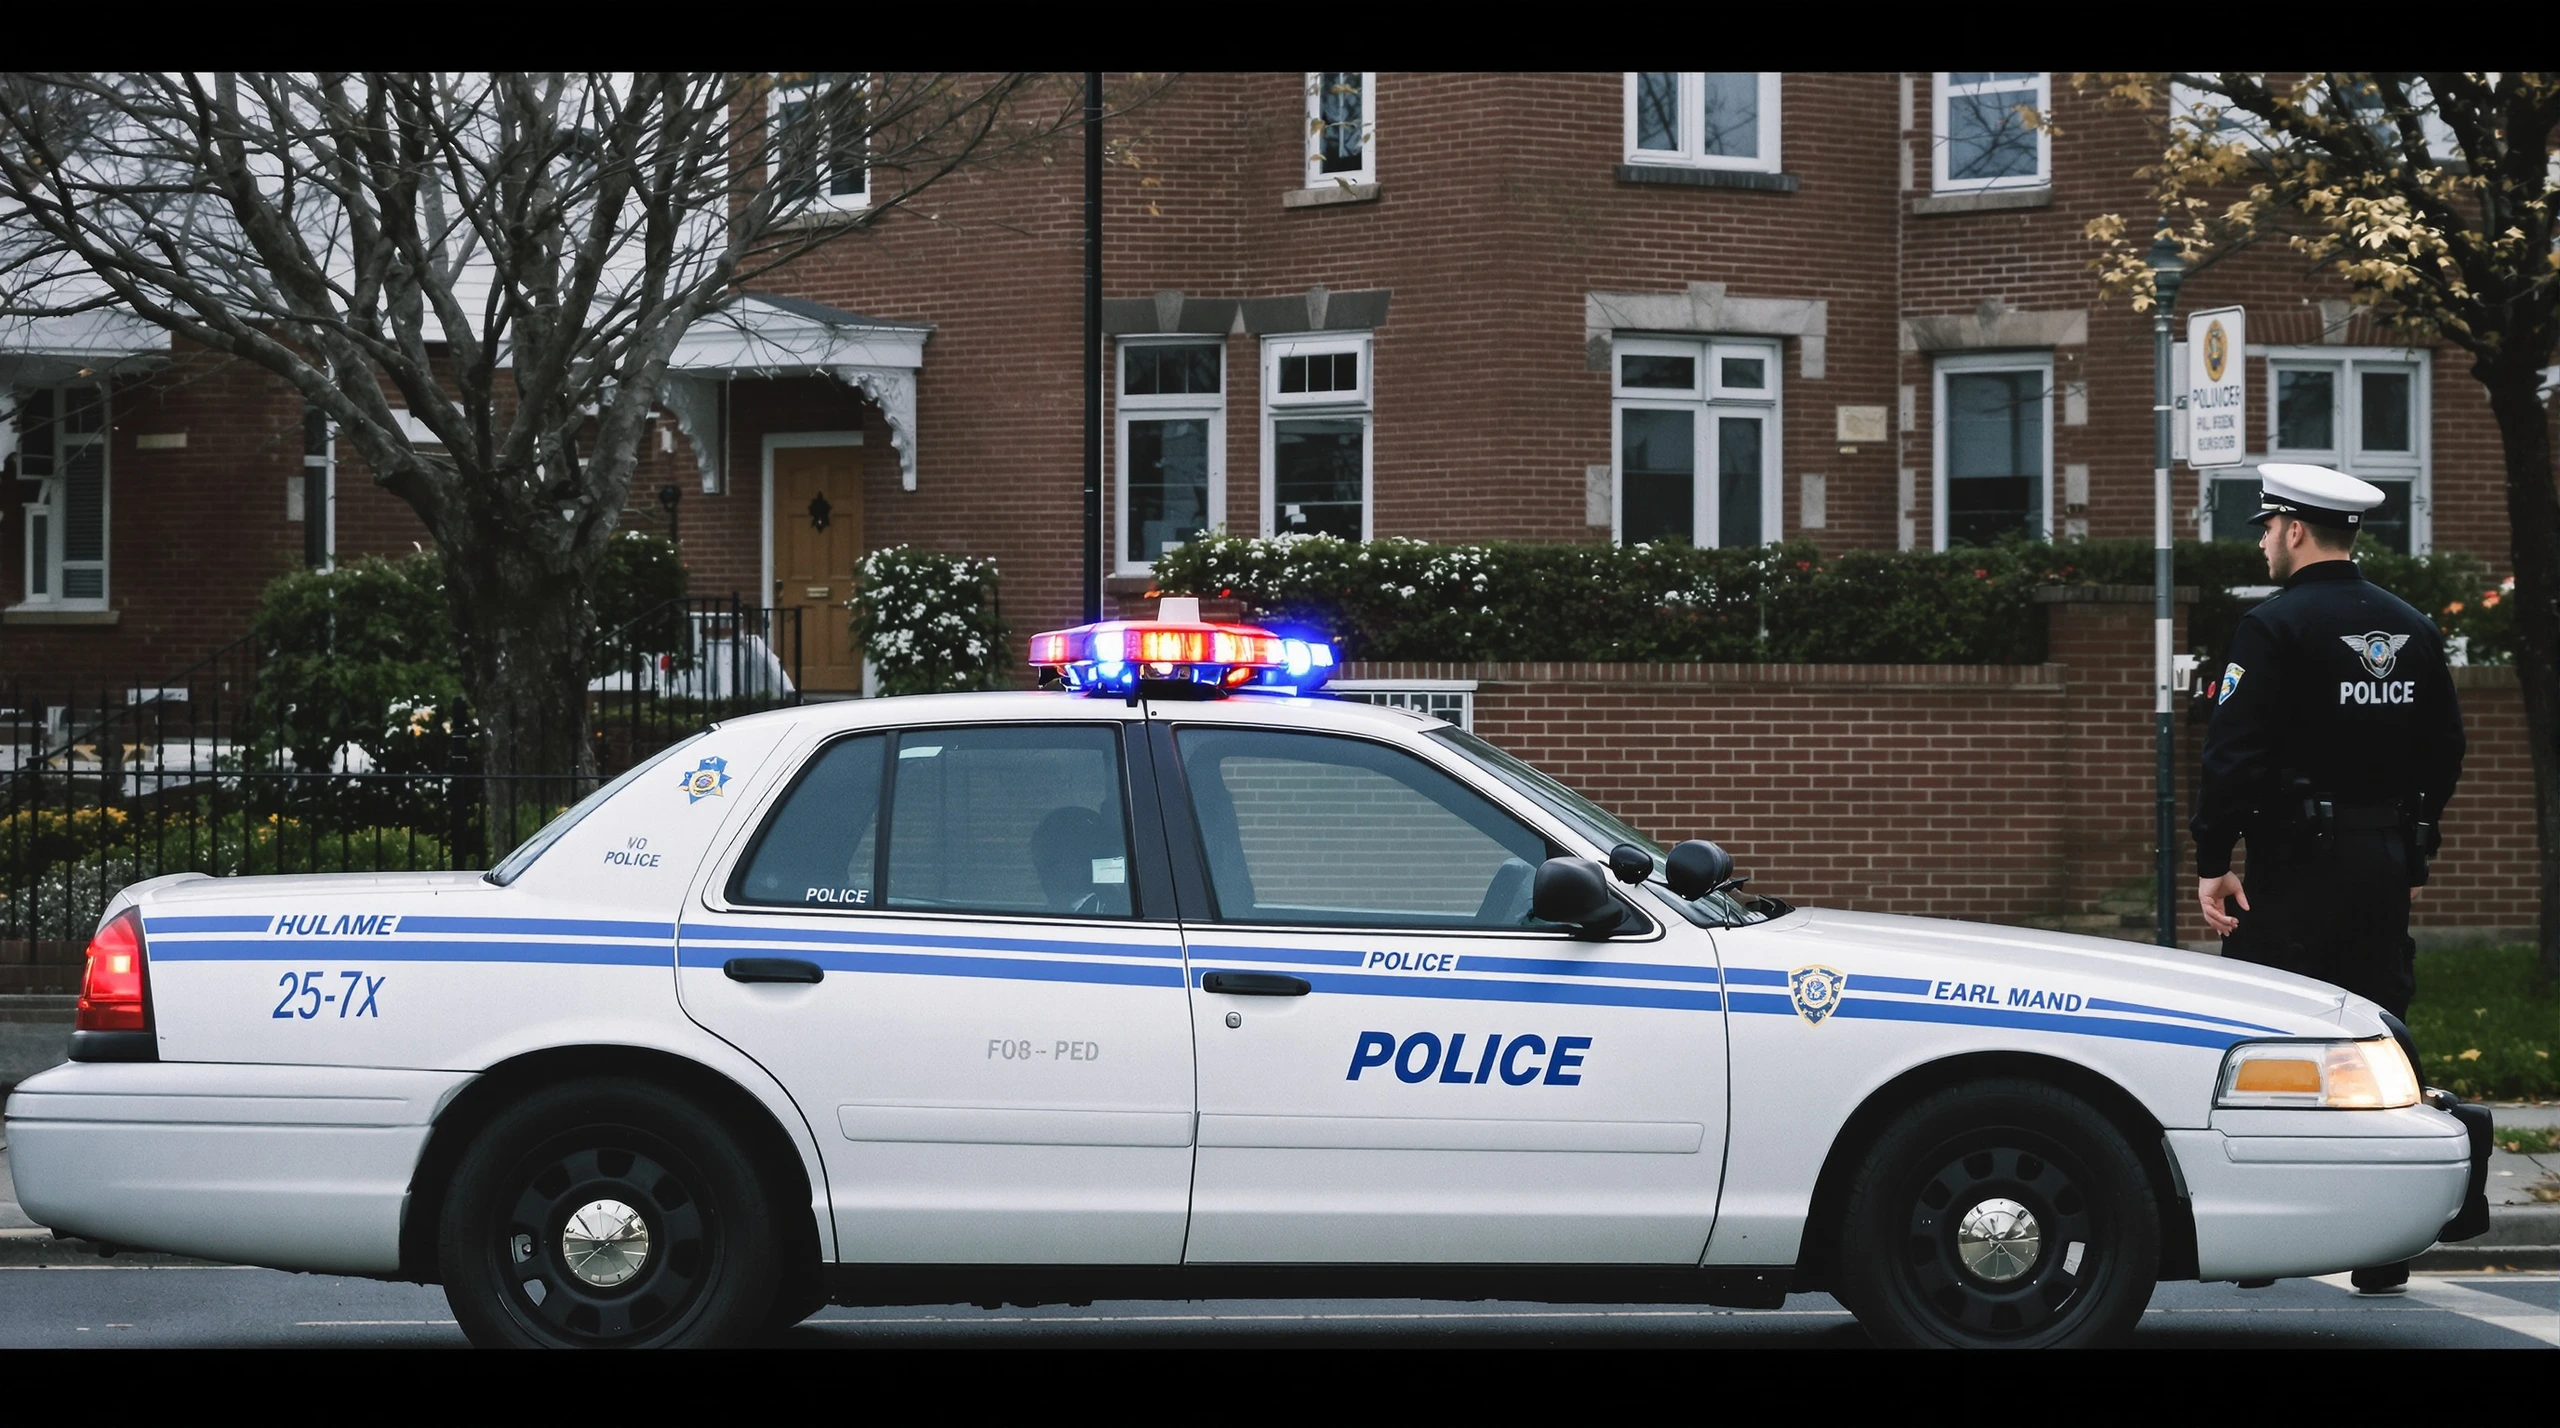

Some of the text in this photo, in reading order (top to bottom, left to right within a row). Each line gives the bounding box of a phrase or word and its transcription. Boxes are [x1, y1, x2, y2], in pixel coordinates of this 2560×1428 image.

[2340, 681, 2415, 705] POLICE
[604, 850, 662, 868] POLICE
[805, 887, 869, 904] POLICE
[275, 914, 396, 936] HULAME
[1368, 951, 1454, 972] POLICE
[271, 970, 387, 1020] 25-7X
[1934, 980, 2082, 1012] EARL MAND
[1346, 1030, 1593, 1087] POLICE
